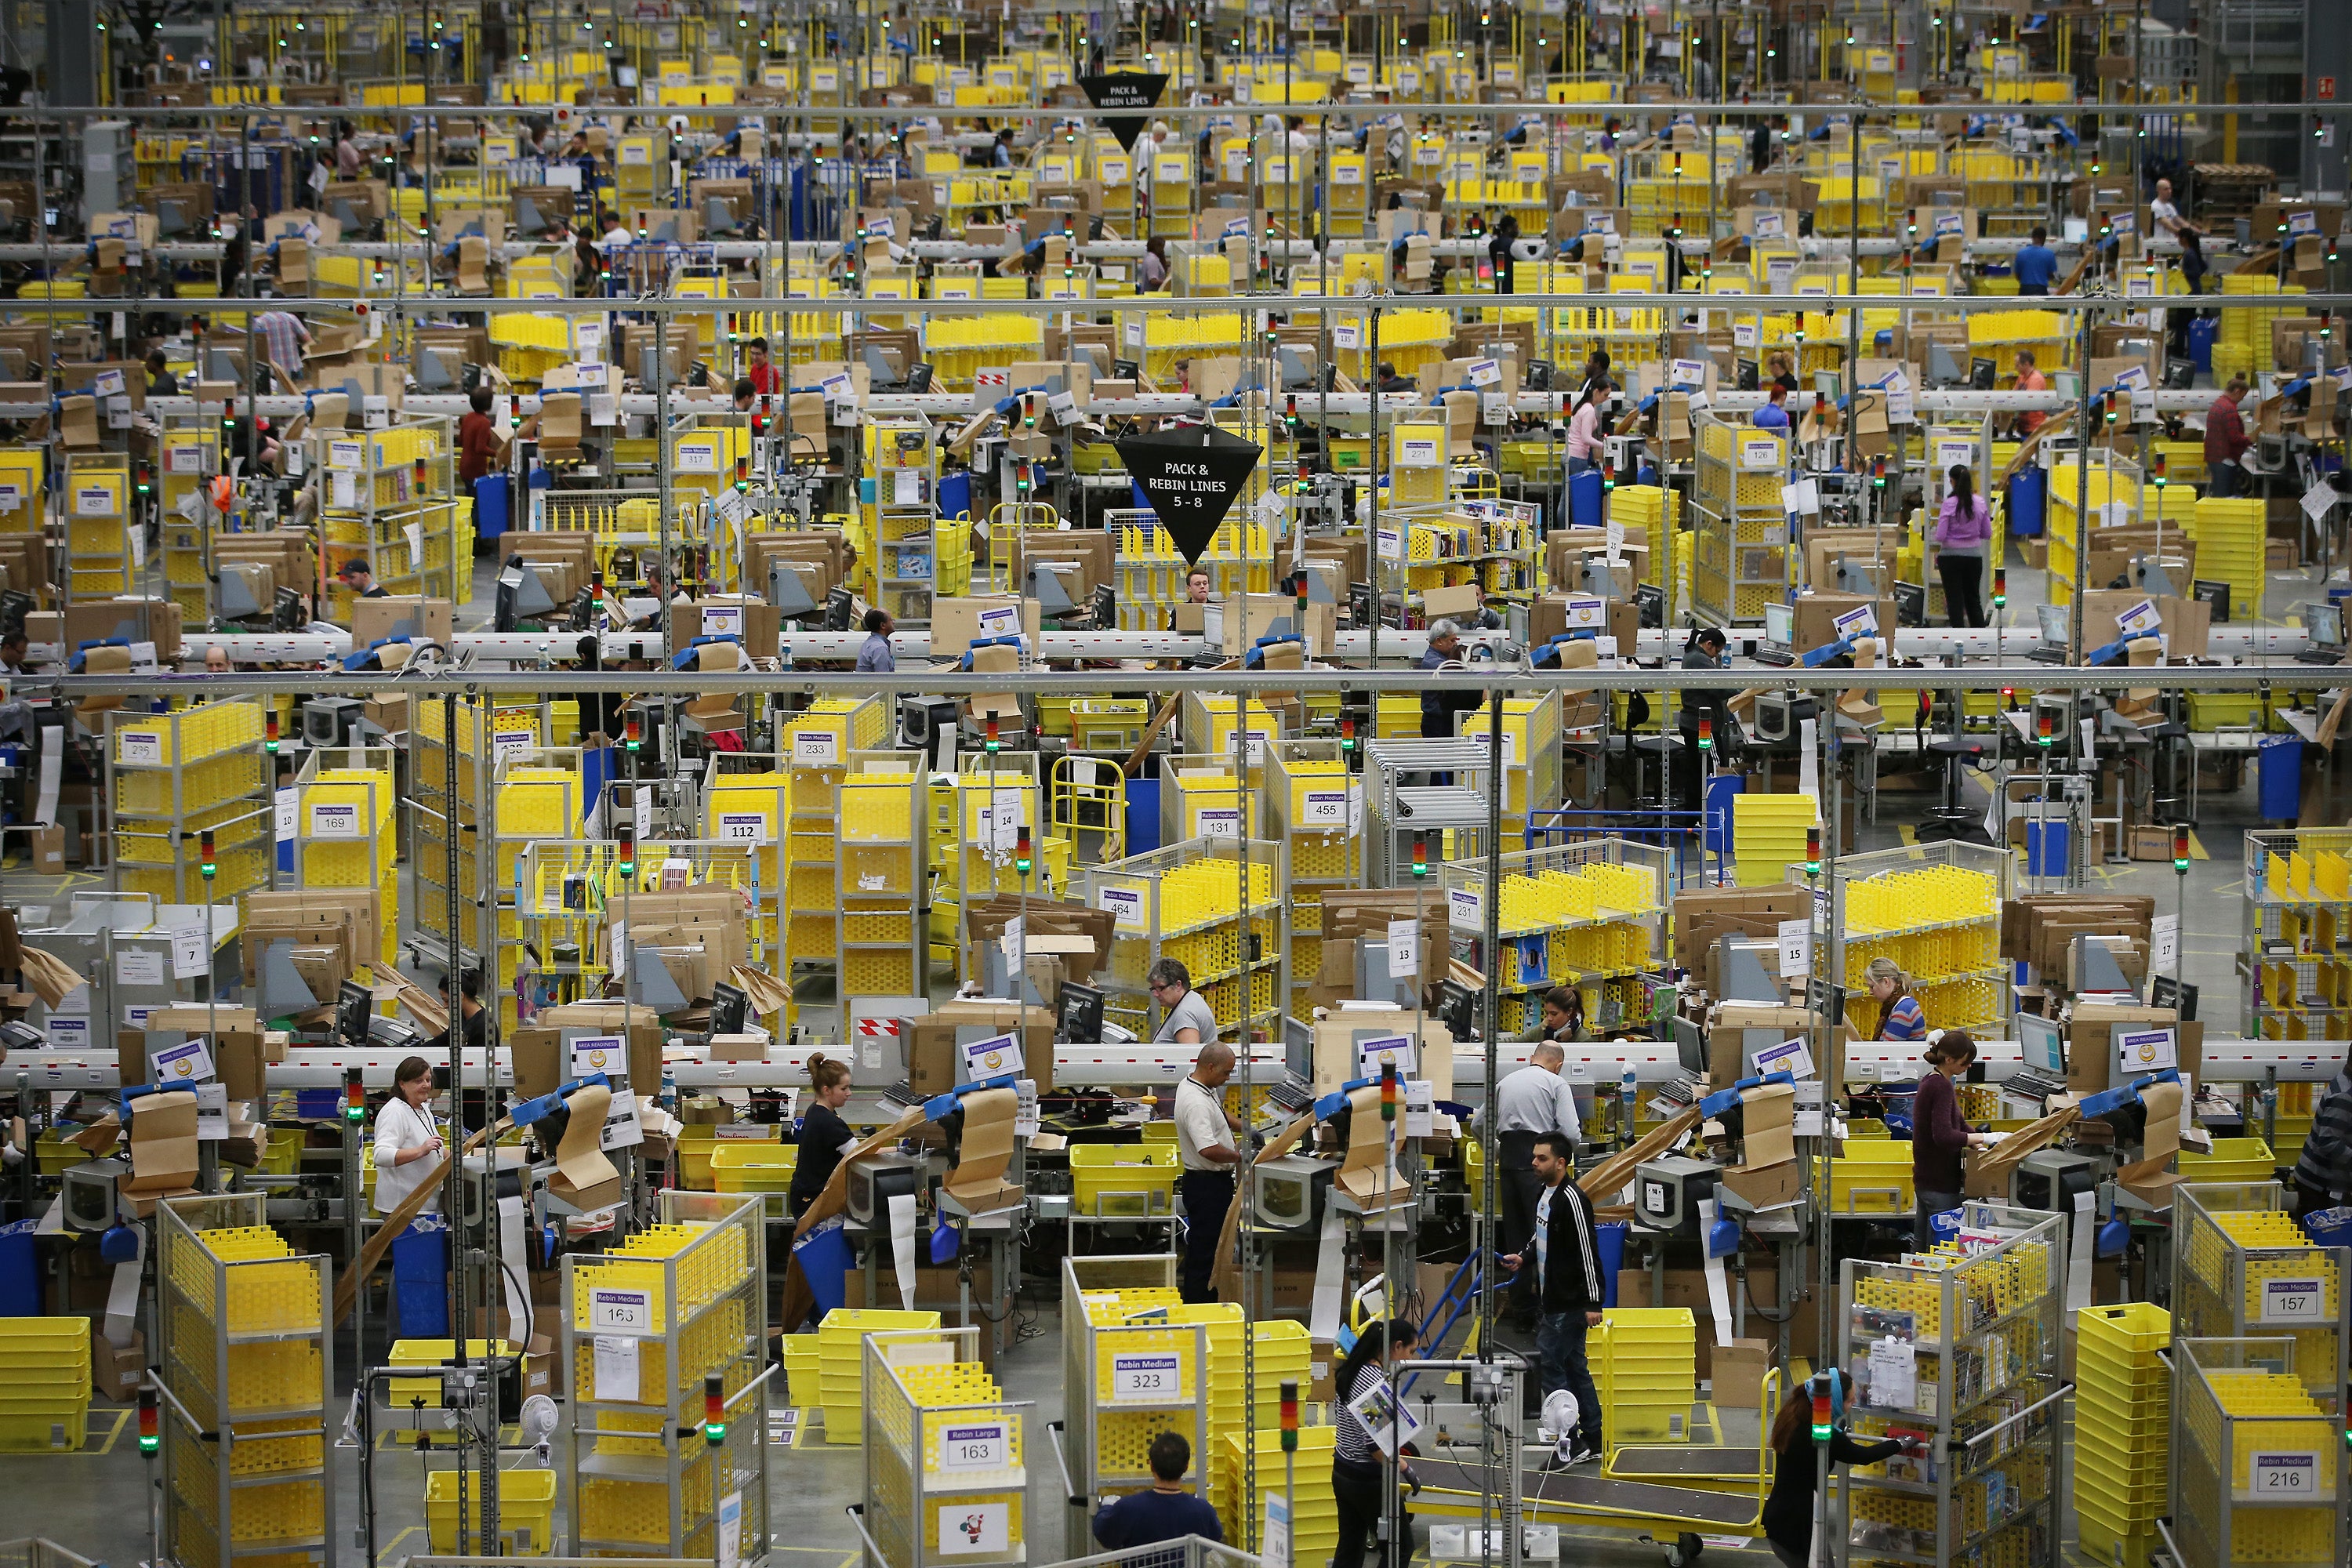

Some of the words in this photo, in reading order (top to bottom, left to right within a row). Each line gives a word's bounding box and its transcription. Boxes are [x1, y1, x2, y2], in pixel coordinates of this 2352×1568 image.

[1110, 86, 1130, 95] PACK
[1131, 86, 1138, 95] &
[1100, 97, 1124, 107] REBIN
[1126, 96, 1149, 106] LINES
[1165, 463, 1196, 476] PACK
[1199, 463, 1209, 476] &
[1149, 478, 1186, 491] REBIN
[1190, 480, 1226, 492] LINES
[1174, 497, 1181, 507] 5
[1195, 498, 1203, 508] 8
[1381, 541, 1392, 550] 467
[805, 745, 824, 754] 233
[1316, 805, 1336, 815] 455
[325, 818, 344, 828] 169
[1003, 816, 1011, 826] 14
[731, 826, 753, 837] 112
[1210, 823, 1229, 832] 131
[1111, 904, 1129, 914] 464
[1457, 906, 1472, 917] 231
[189, 951, 195, 960] 7
[1399, 950, 1409, 960] 13
[1790, 949, 1800, 959] 15
[2162, 946, 2171, 955] 17
[983, 1040, 1010, 1050] READINESS
[1378, 1040, 1406, 1048] READINESS
[161, 1053, 172, 1062] AREA
[173, 1046, 199, 1058] READINESS
[1771, 1044, 1798, 1058] READINESS
[2281, 1298, 2306, 1310] 157
[1132, 1374, 1160, 1388] 323
[960, 1444, 988, 1459] 163
[2270, 1472, 2299, 1486] 216
